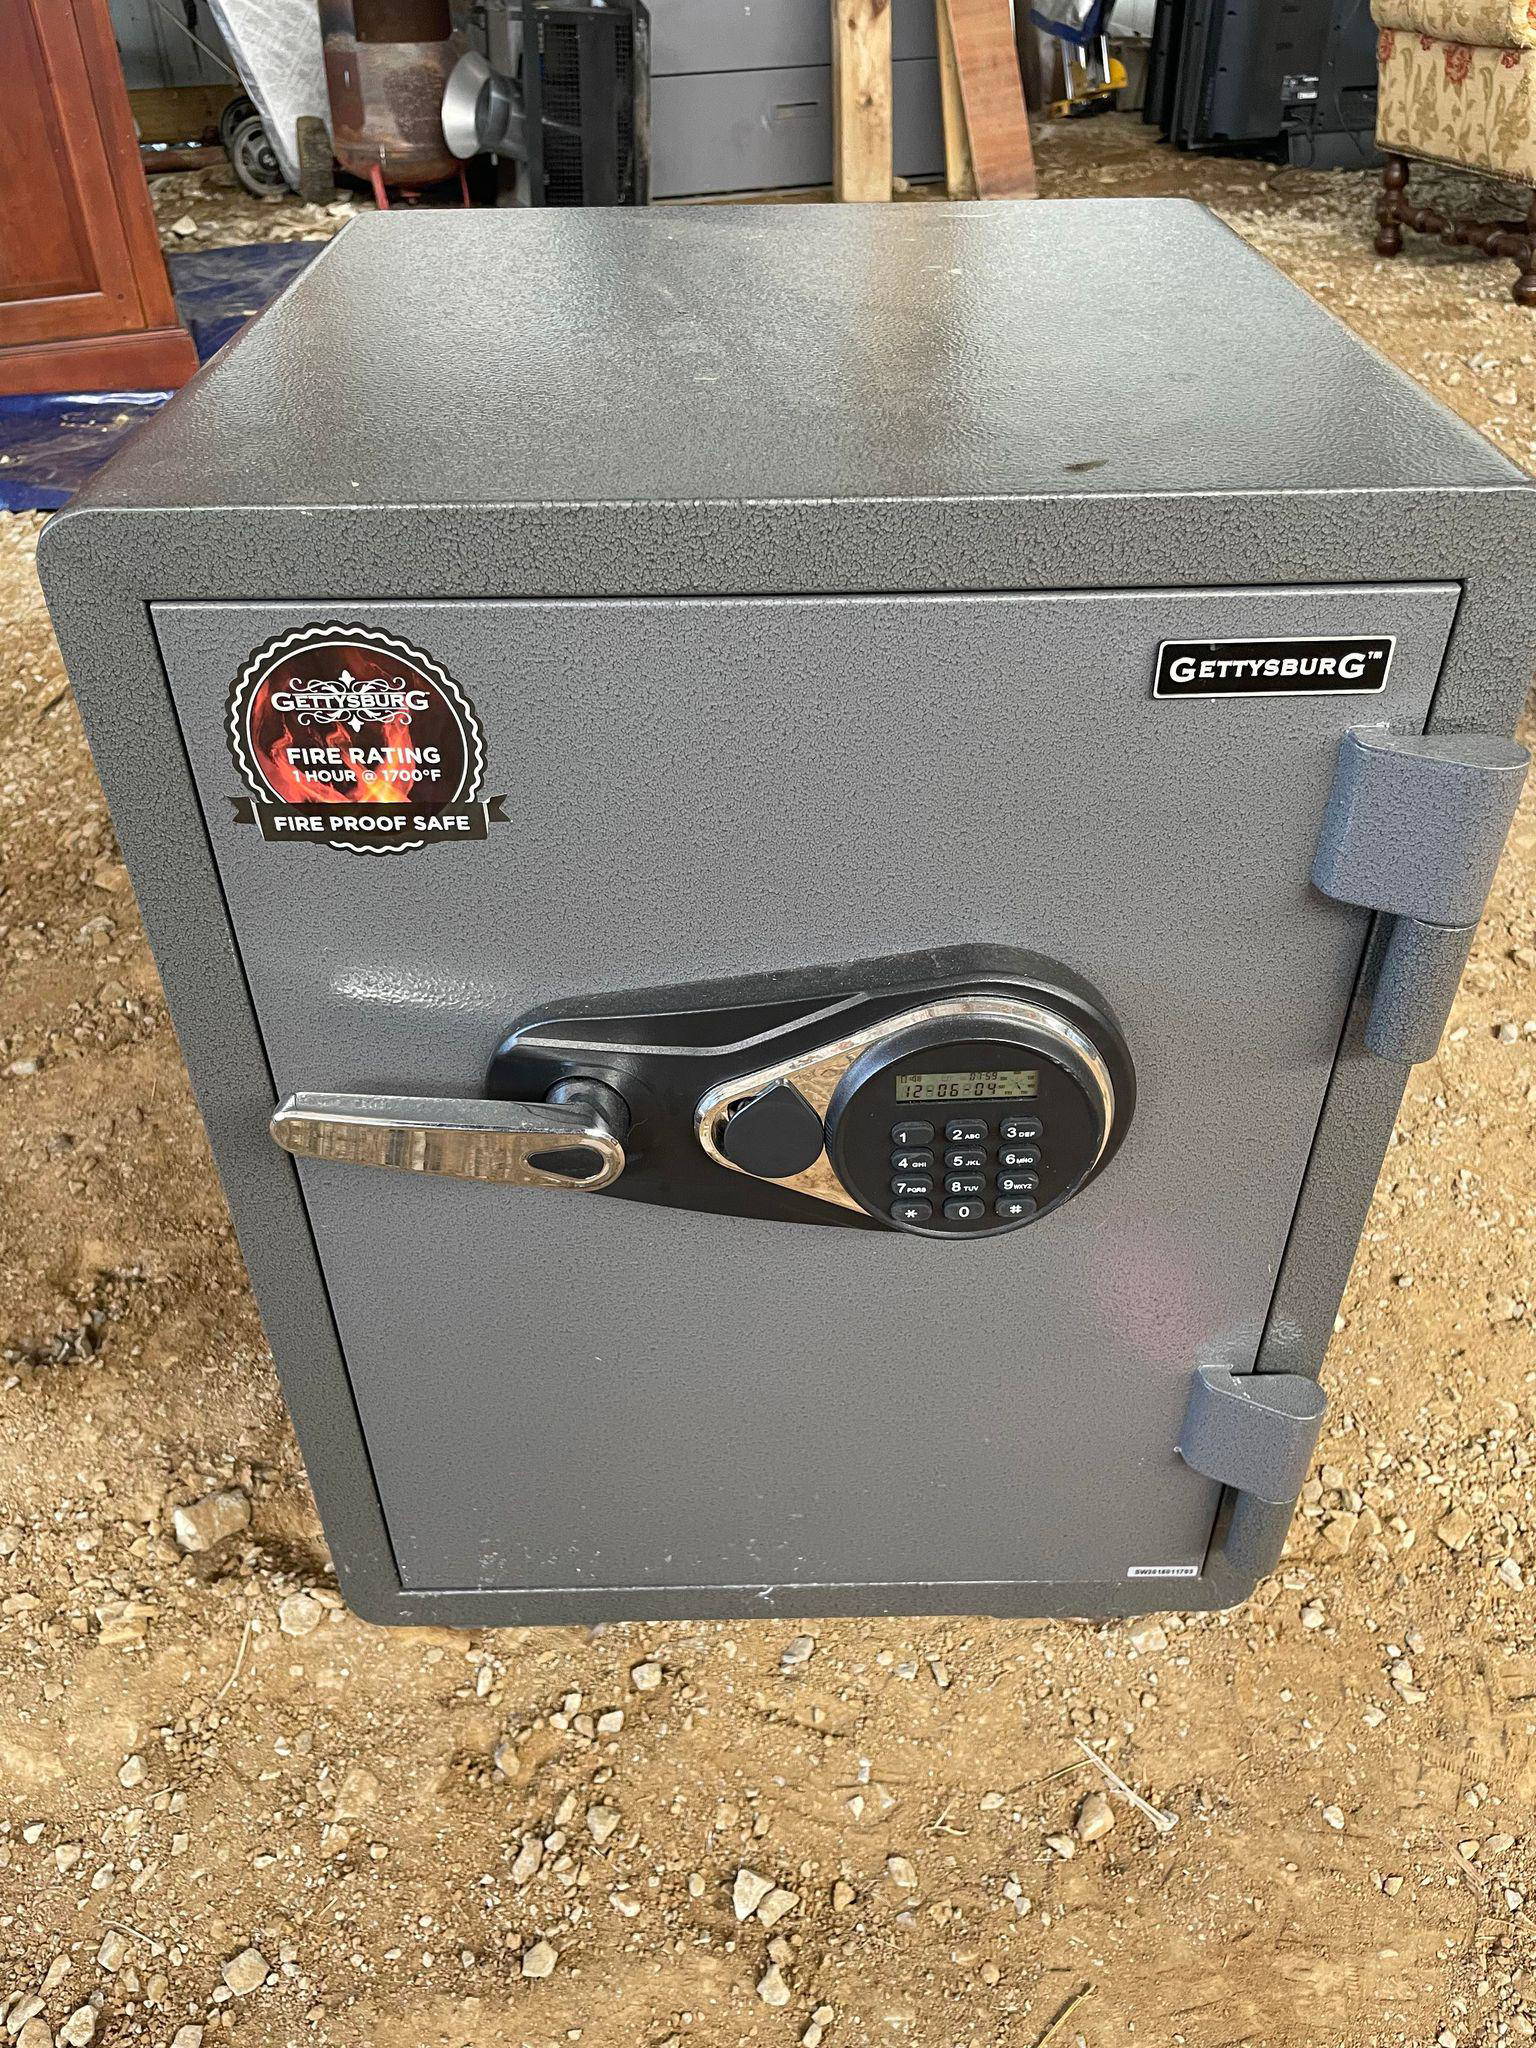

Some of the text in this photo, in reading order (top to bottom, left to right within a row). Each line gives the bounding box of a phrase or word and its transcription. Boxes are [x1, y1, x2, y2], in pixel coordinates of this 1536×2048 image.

[1169, 652, 1366, 683] GETTYSBURG
[271, 690, 430, 712] GETTYSBURG
[286, 746, 441, 765] FIRE RATING
[292, 768, 442, 784] 1 HOUR @ 1700°F
[273, 815, 471, 832] FIRE PROOF SAFE
[899, 1132, 906, 1143] 1
[952, 1129, 963, 1140] 2
[1006, 1127, 1017, 1138] 3
[898, 1157, 909, 1169] 4
[953, 1155, 964, 1167] 5
[1005, 1153, 1016, 1165] 6
[896, 1182, 907, 1194] 7
[951, 1181, 962, 1193] 8
[1003, 1179, 1014, 1190] 9
[958, 1206, 970, 1218] 0
